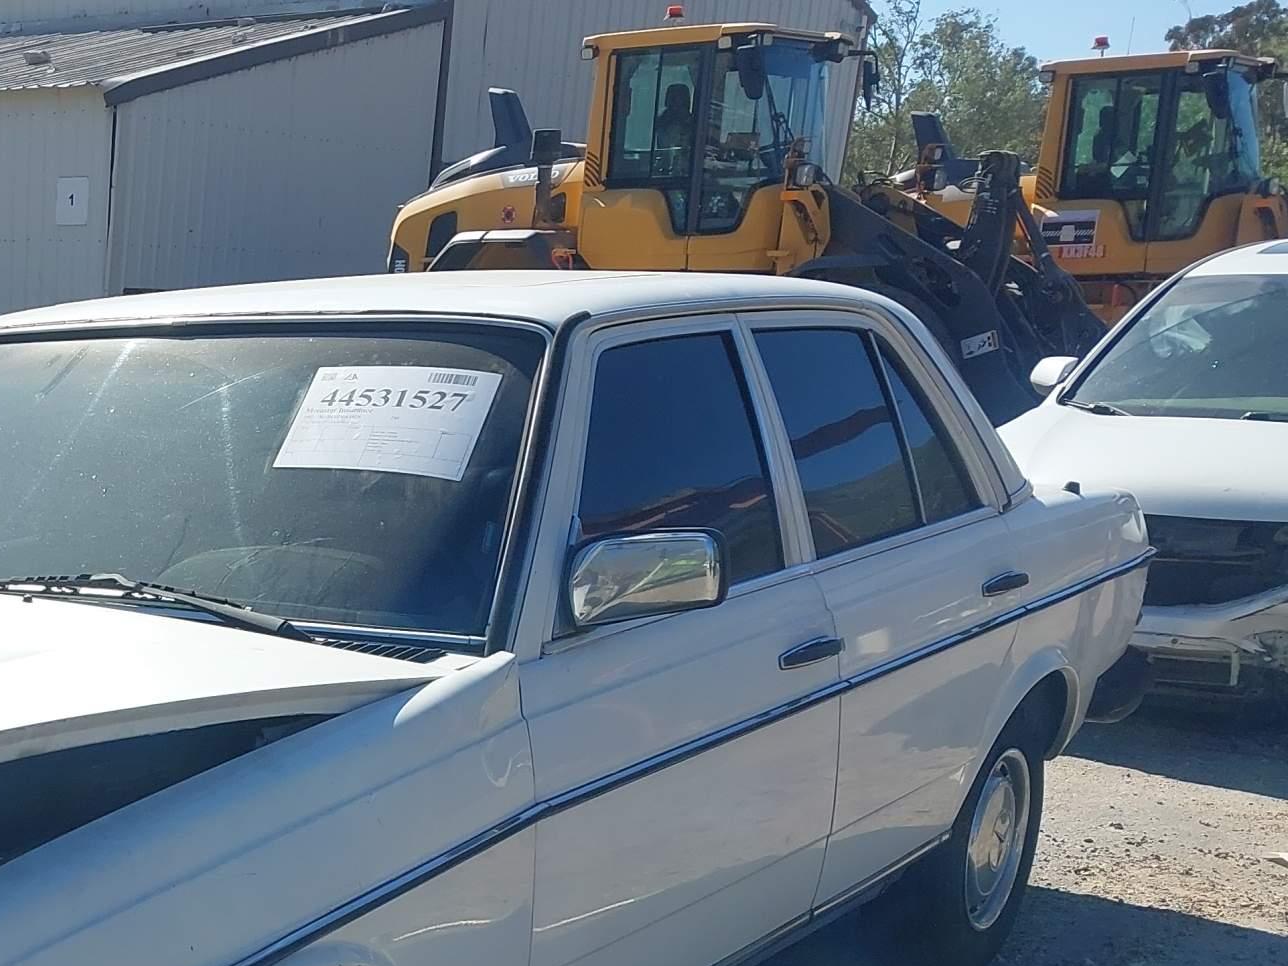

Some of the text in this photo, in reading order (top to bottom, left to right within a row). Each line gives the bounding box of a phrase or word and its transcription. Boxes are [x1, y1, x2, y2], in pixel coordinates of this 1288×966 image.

[508, 170, 559, 183] VOLO
[69, 193, 75, 206] 1
[320, 388, 469, 412] 44531527
